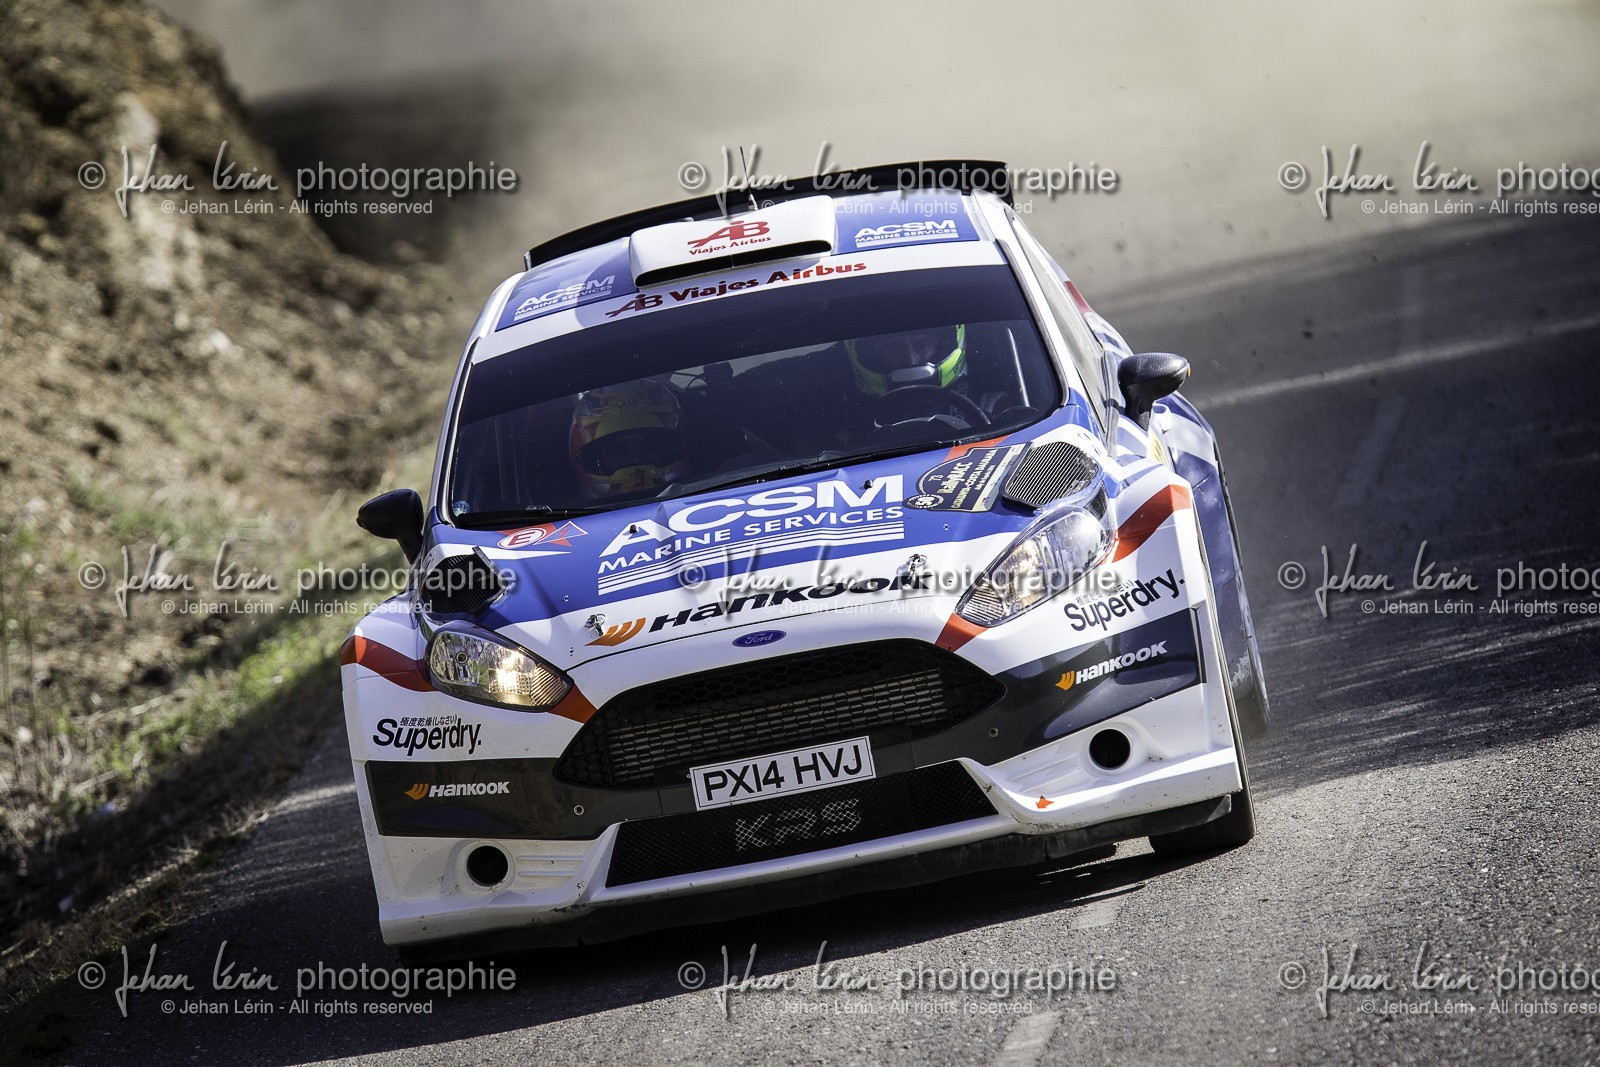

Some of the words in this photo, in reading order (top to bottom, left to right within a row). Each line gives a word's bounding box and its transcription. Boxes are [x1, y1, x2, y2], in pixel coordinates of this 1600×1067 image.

[688, 245, 727, 256] Viajes
[729, 237, 771, 248] Airbus
[854, 219, 957, 239] ACSM
[855, 233, 901, 243] MARINE
[903, 228, 957, 237] SERVICES
[515, 299, 559, 316] MARINE
[561, 285, 613, 301] SERVICES
[516, 275, 616, 311] ACSM
[669, 279, 760, 302] Viajes
[766, 262, 868, 285] Airbus
[598, 474, 904, 558] ACSM
[597, 528, 731, 575] MARINE
[743, 506, 904, 537] SERVICES
[1063, 568, 1186, 632] Superdry.
[372, 717, 482, 757] Superdry.
[702, 759, 786, 801] PX14
[792, 744, 863, 785] HVJ
